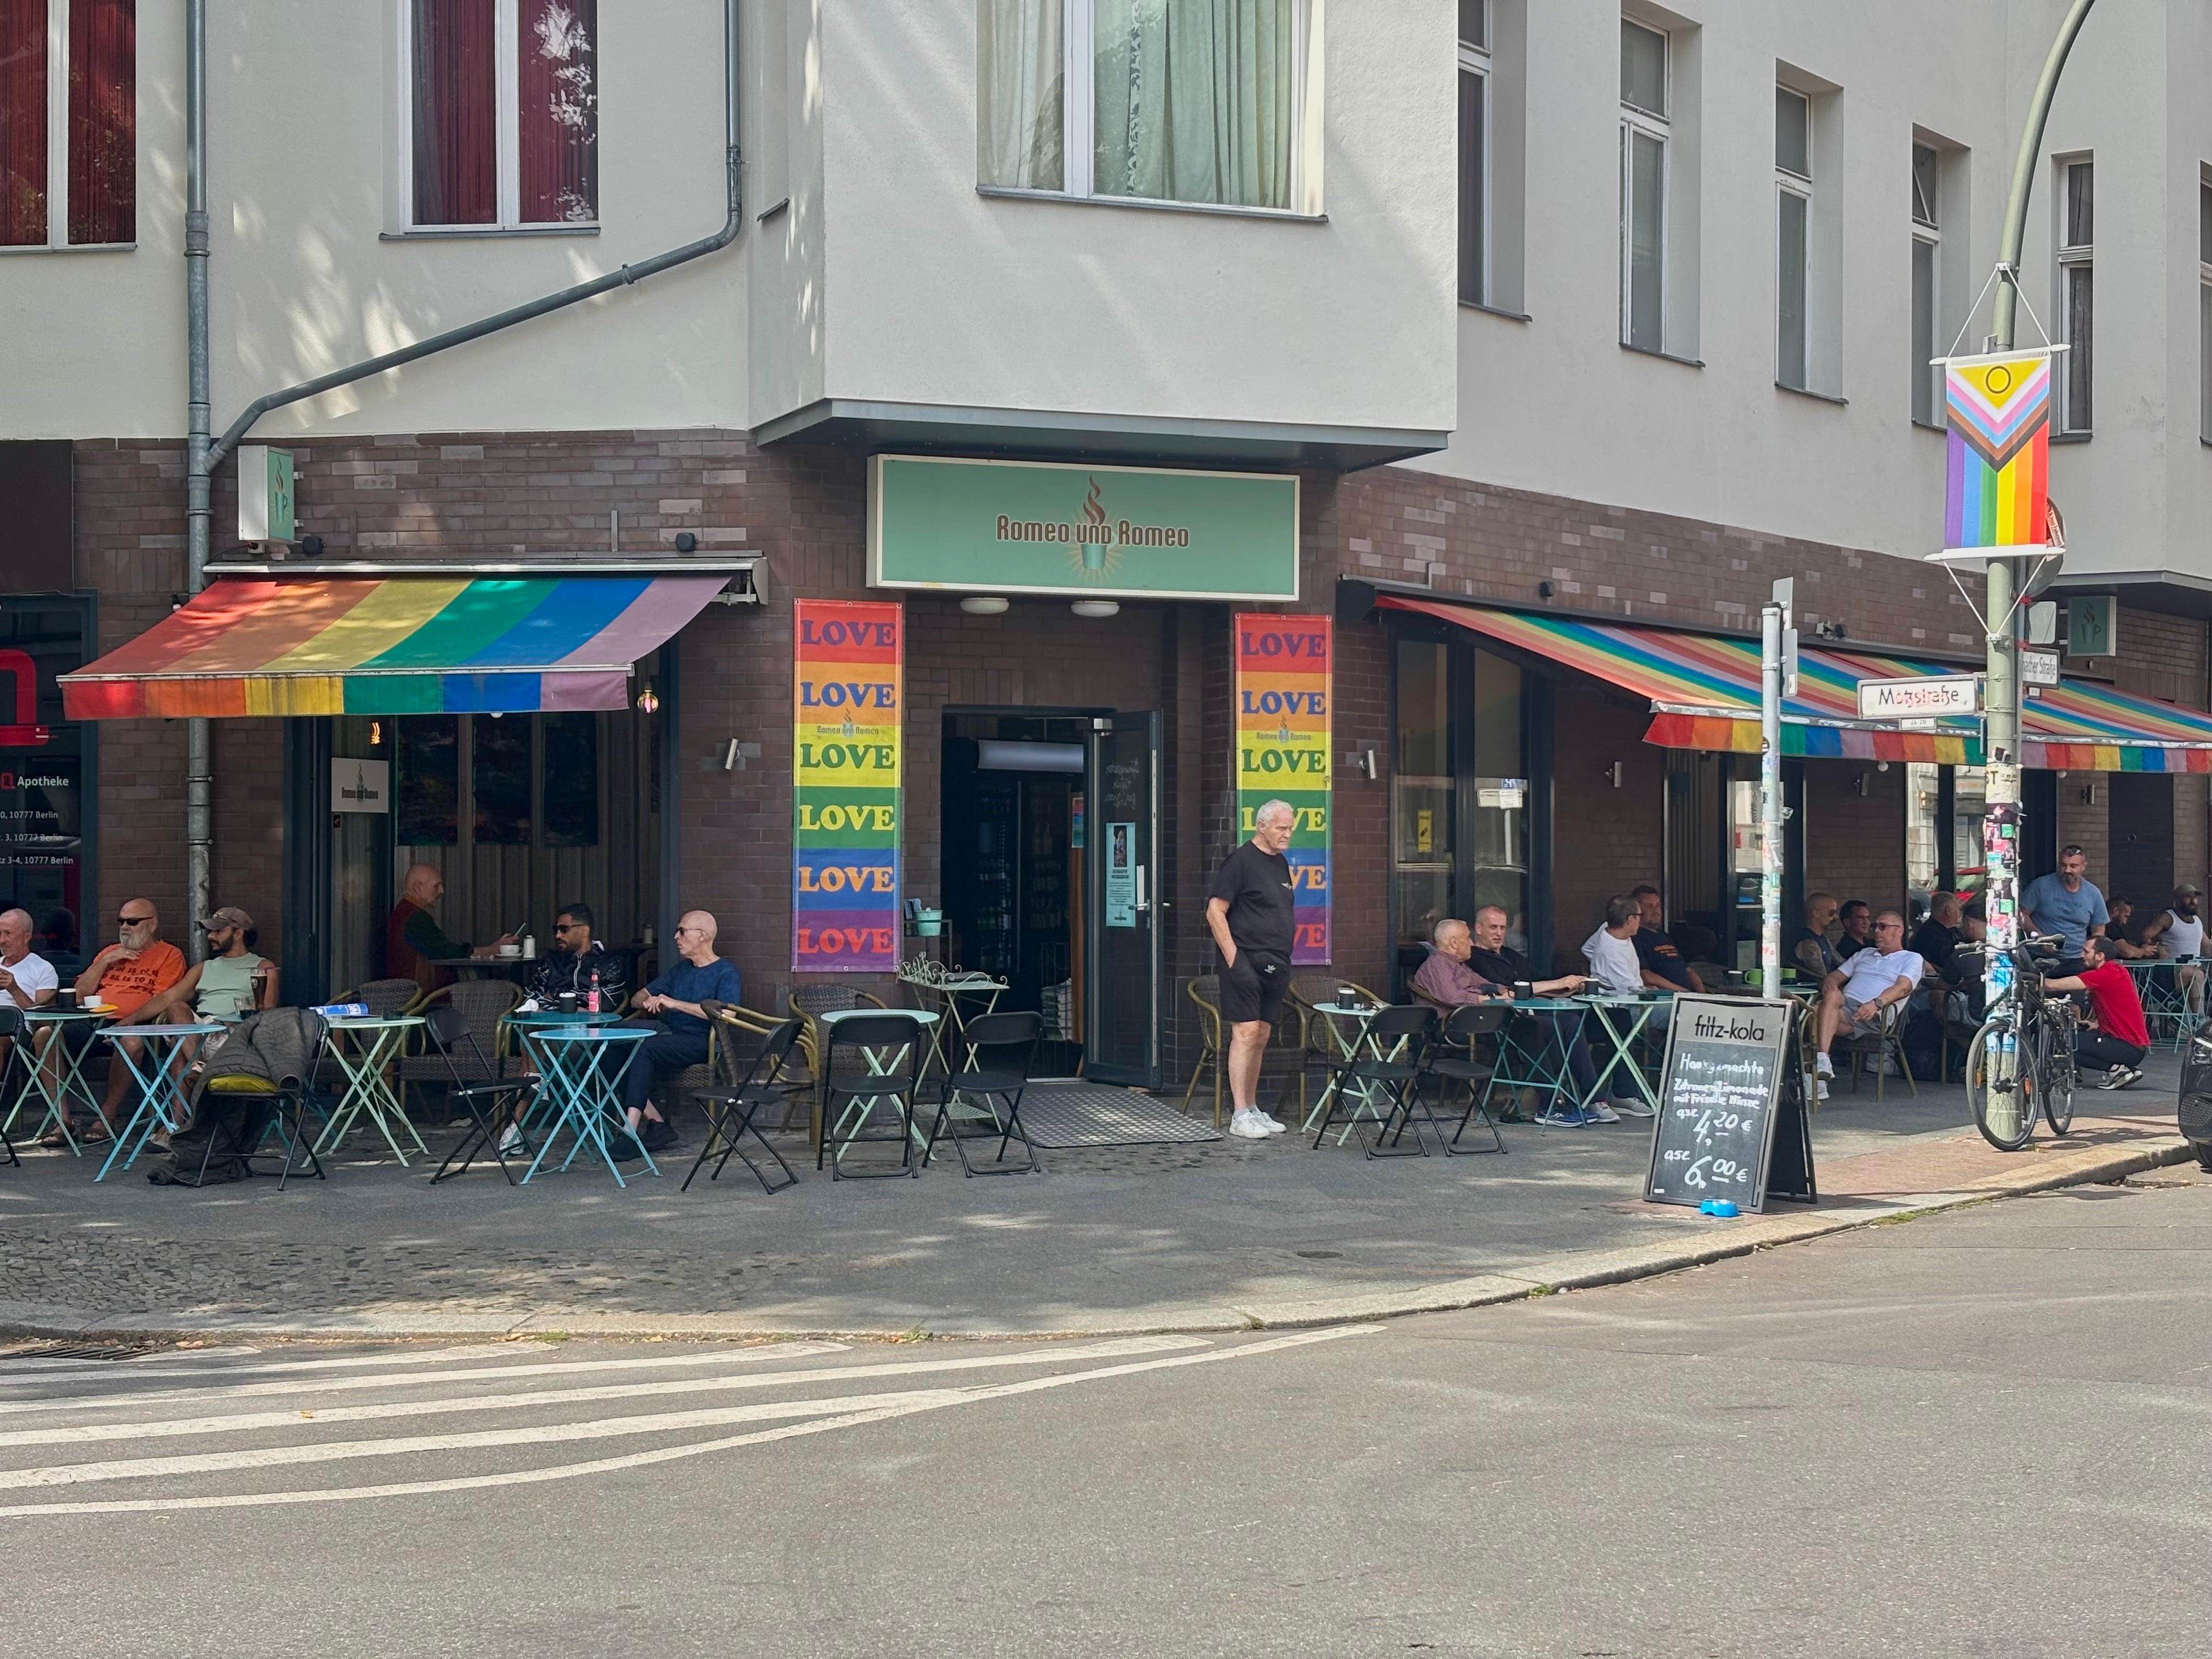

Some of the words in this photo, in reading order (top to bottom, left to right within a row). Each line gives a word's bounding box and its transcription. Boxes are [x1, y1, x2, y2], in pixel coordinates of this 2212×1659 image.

[997, 515, 1070, 543] Romeo
[1118, 520, 1189, 548] Romeo
[801, 619, 896, 647] LOVE
[1241, 632, 1326, 658] LOVE
[2022, 656, 2039, 674] acher
[2039, 656, 2056, 680] Straße
[800, 681, 895, 708] LOVE
[1242, 690, 1326, 715] LOVE
[800, 743, 895, 769] LOVE
[1242, 749, 1326, 773] LOVE
[17, 776, 69, 789] Apotheke
[799, 805, 895, 831] LOVE
[40, 833, 64, 842] Berlin
[7, 856, 22, 865] 3-4,
[799, 867, 894, 892] LOVE
[798, 928, 894, 953] LOVE
[1695, 1014, 1765, 1041] fritz-kola
[1741, 1120, 1753, 1132] €
[1735, 1169, 1748, 1182] €
